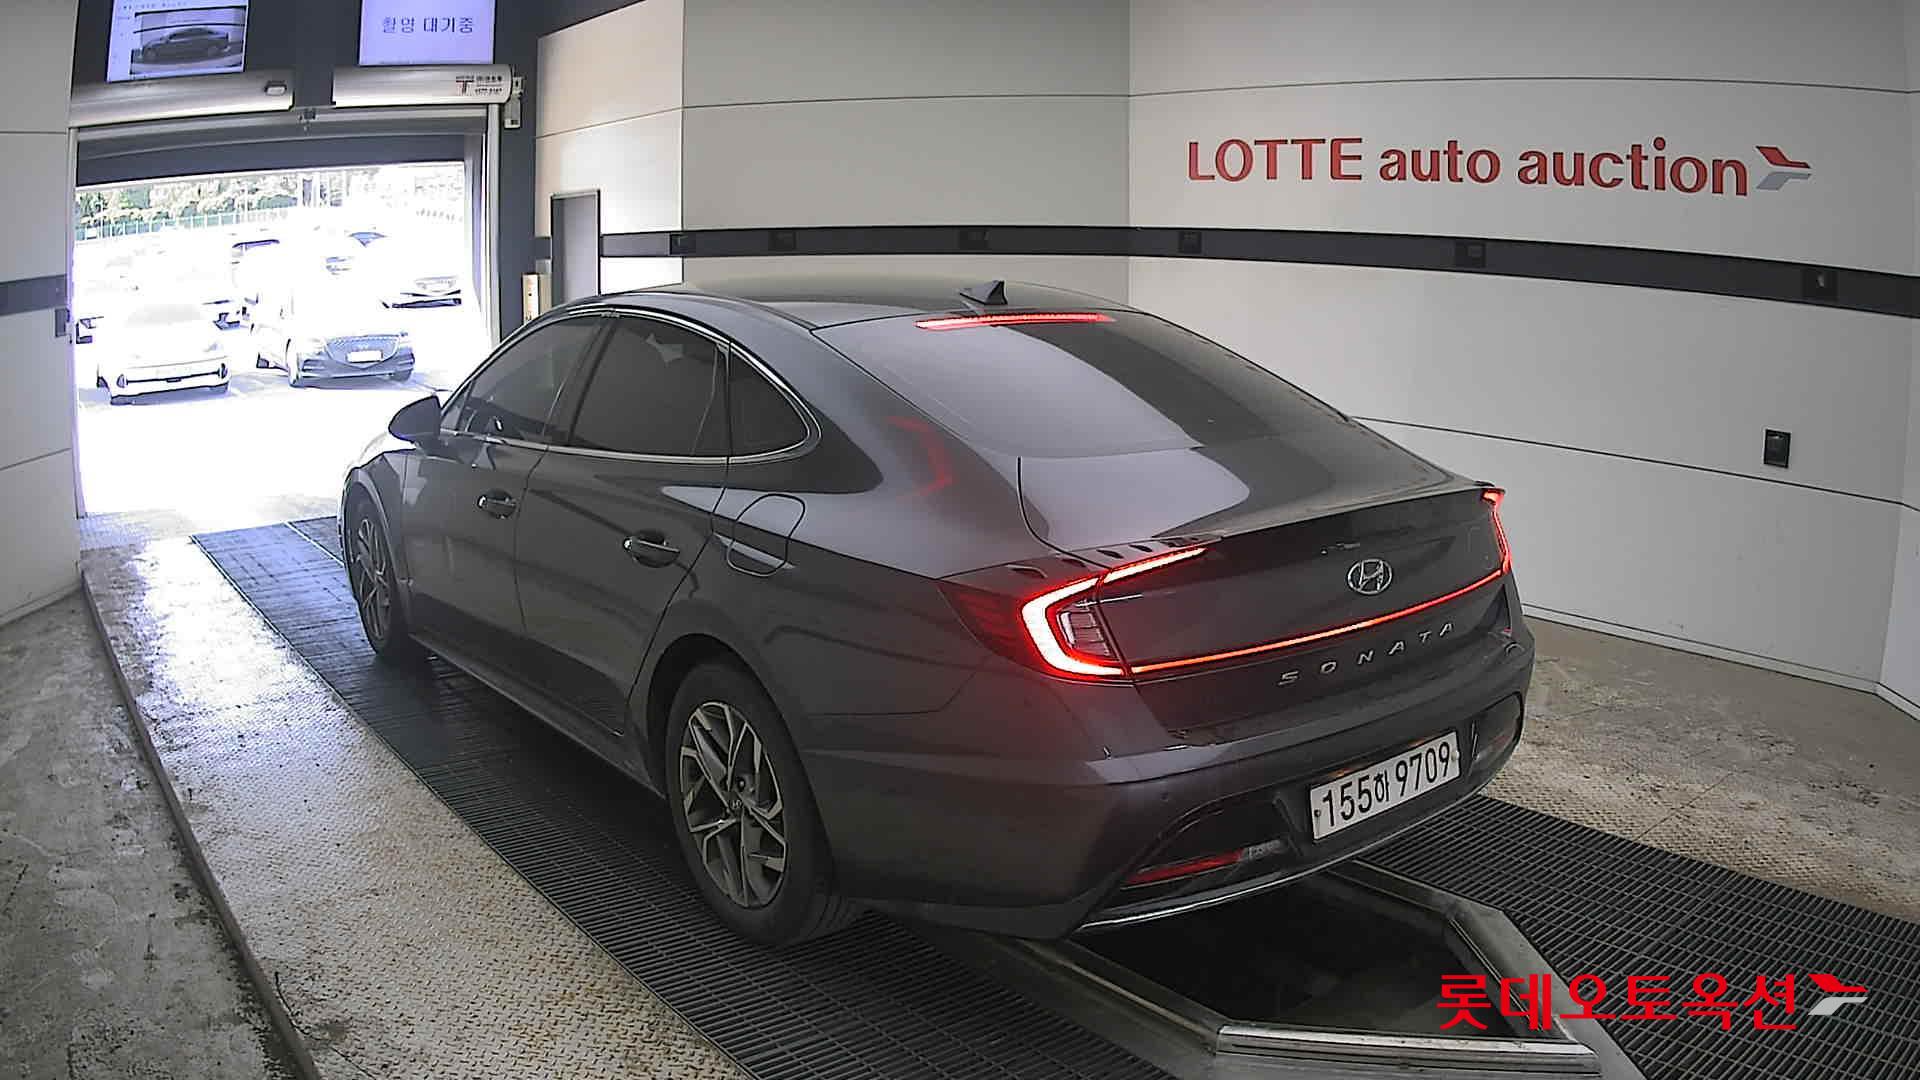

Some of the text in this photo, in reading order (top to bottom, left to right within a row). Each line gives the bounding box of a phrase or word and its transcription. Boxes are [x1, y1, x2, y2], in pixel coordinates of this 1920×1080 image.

[423, 16, 473, 34] 대기중
[1188, 137, 1748, 197] LOTTE auto auction
[1277, 622, 1455, 686] SONATA
[1395, 741, 1451, 797] 9709
